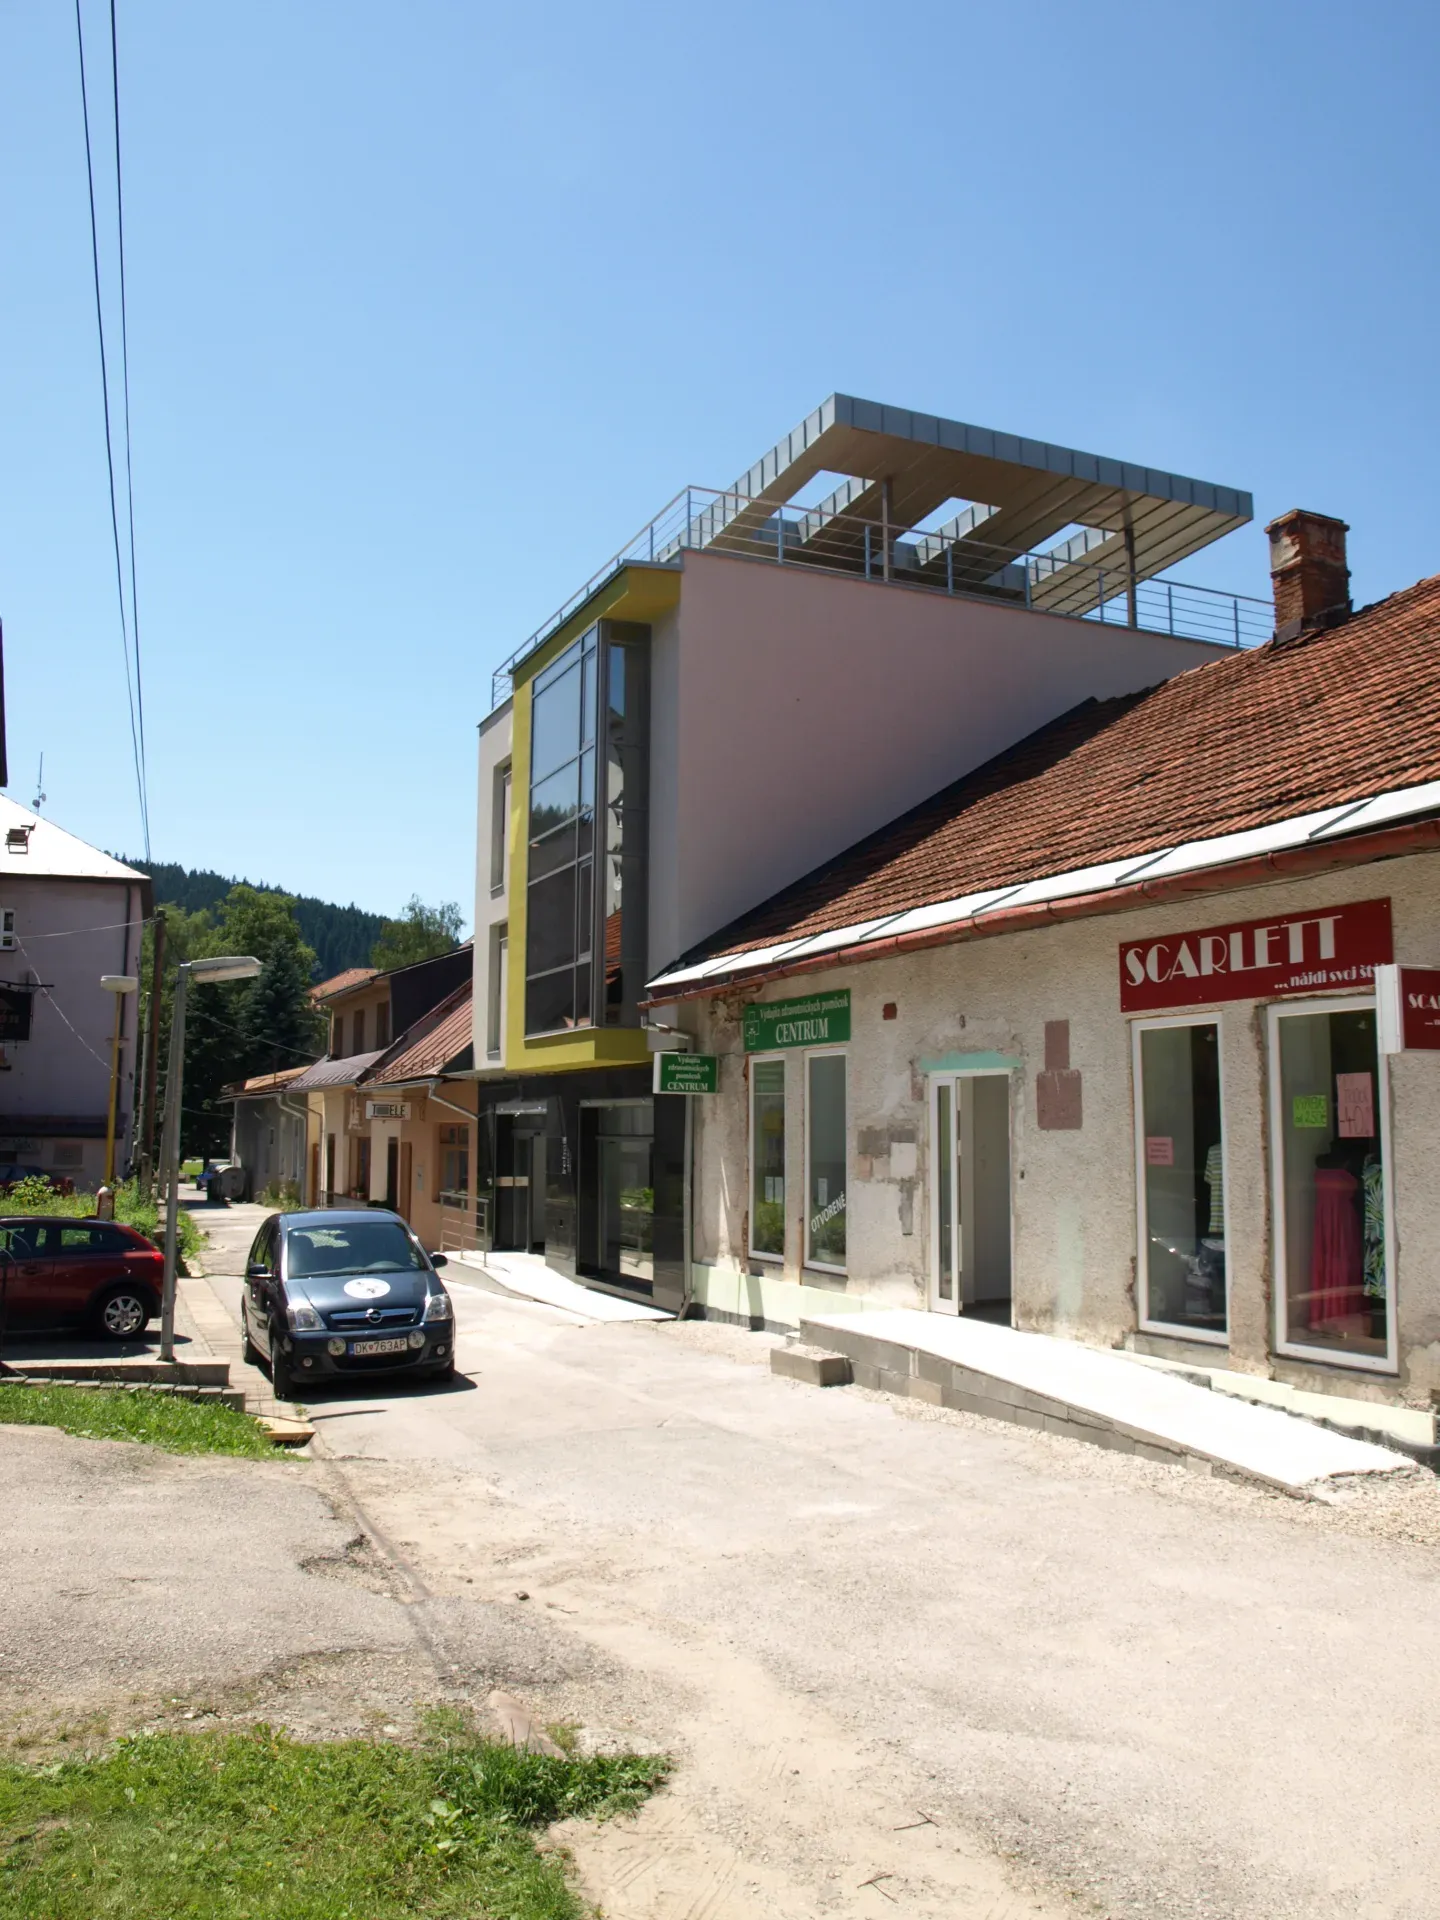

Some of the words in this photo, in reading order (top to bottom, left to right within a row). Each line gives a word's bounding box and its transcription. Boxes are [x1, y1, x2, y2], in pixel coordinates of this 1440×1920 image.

[1125, 914, 1343, 987] SCARLETT
[1329, 965, 1357, 983] svoj
[775, 1017, 829, 1044] CENTRUM
[667, 1081, 708, 1091] CENTRUM
[810, 1190, 847, 1232] OTVORENÉ
